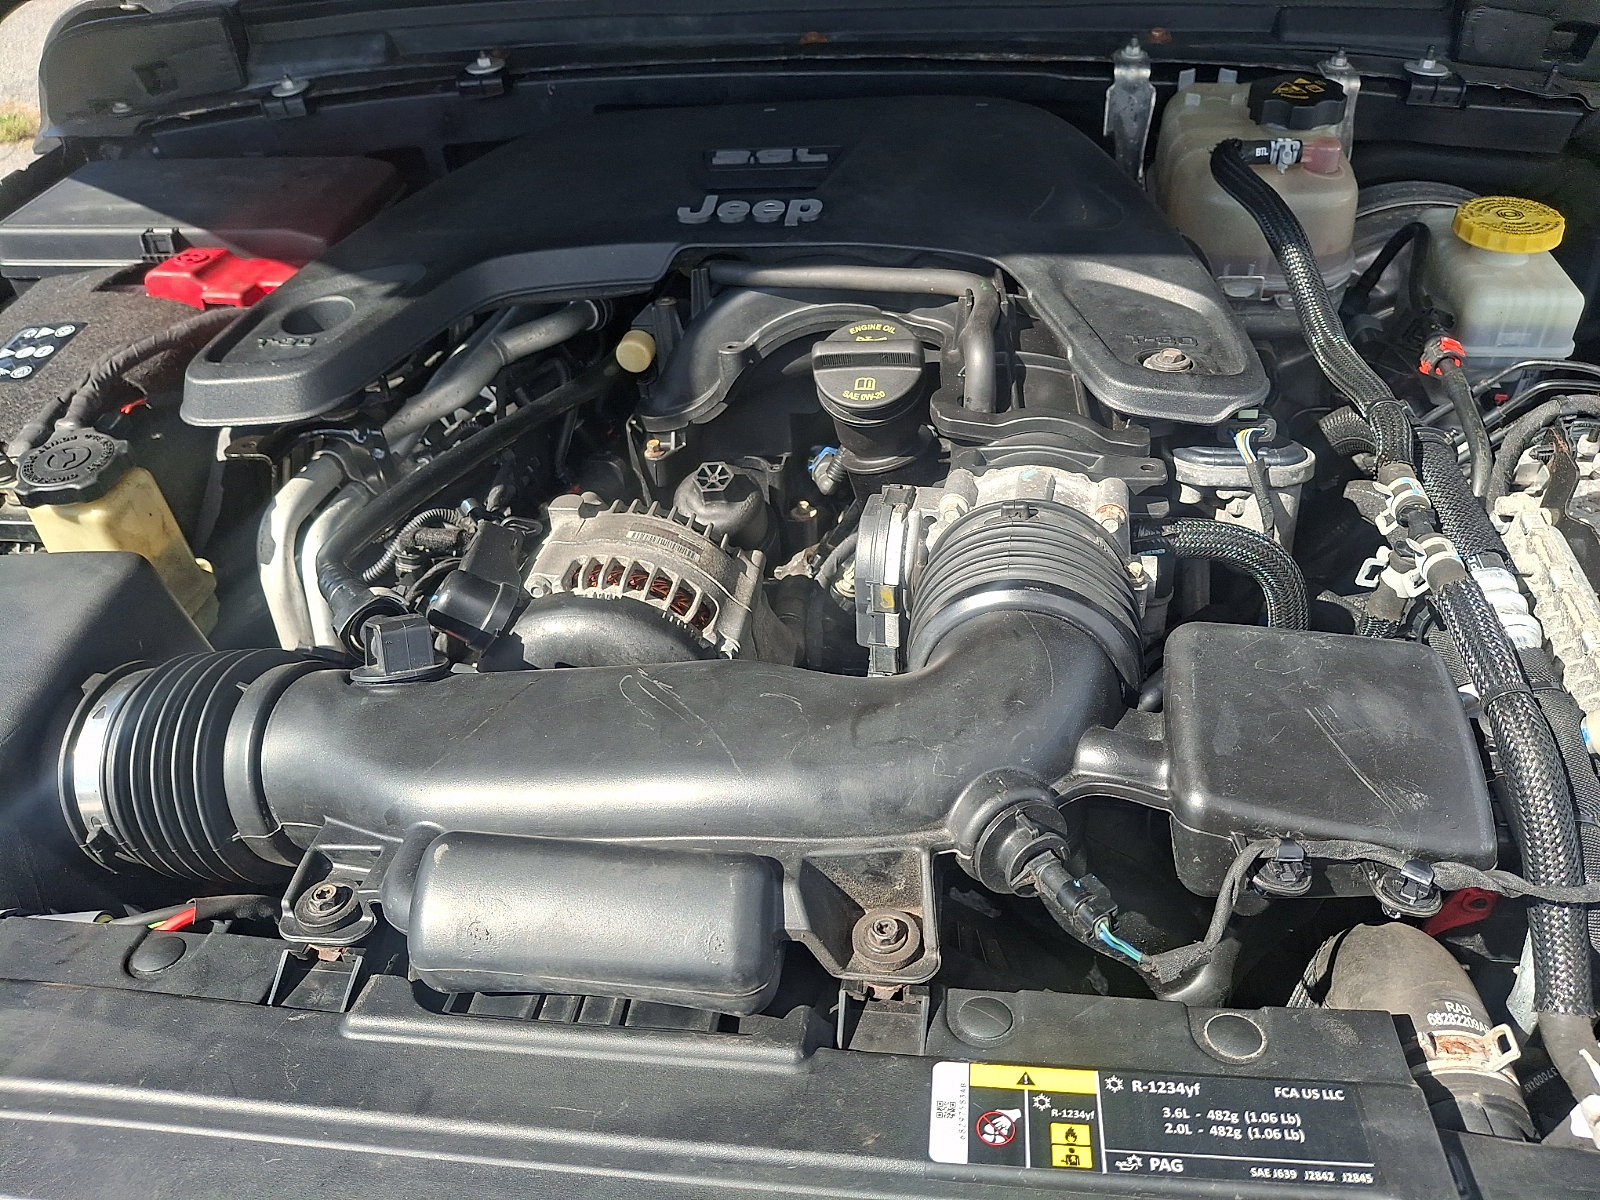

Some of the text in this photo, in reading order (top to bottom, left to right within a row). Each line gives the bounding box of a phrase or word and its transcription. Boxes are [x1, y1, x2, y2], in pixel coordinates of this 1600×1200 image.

[1255, 146, 1269, 157] BTL
[677, 195, 823, 226] Jeep
[849, 324, 896, 334] ENGINE OIL
[842, 390, 886, 401] SAE 0W-20
[1444, 1001, 1472, 1016] RAD
[1131, 1079, 1201, 1098] R-1234yf
[1274, 1086, 1345, 1101] FCA US LLC
[1050, 1109, 1096, 1121] R-1234yf
[1161, 1106, 1191, 1119] 3.6L
[1206, 1109, 1239, 1124] 482g
[1244, 1110, 1279, 1125] (1.06
[1280, 1113, 1301, 1127] Lb)
[1164, 1122, 1193, 1136] 2.0L
[1209, 1125, 1243, 1140] 482g
[1247, 1126, 1282, 1141] (1.06
[1283, 1128, 1306, 1144] Lb)
[1149, 1157, 1184, 1173] PAG
[1249, 1167, 1272, 1179] SAE
[1271, 1168, 1298, 1180] J639
[1341, 1172, 1374, 1184] J2845
